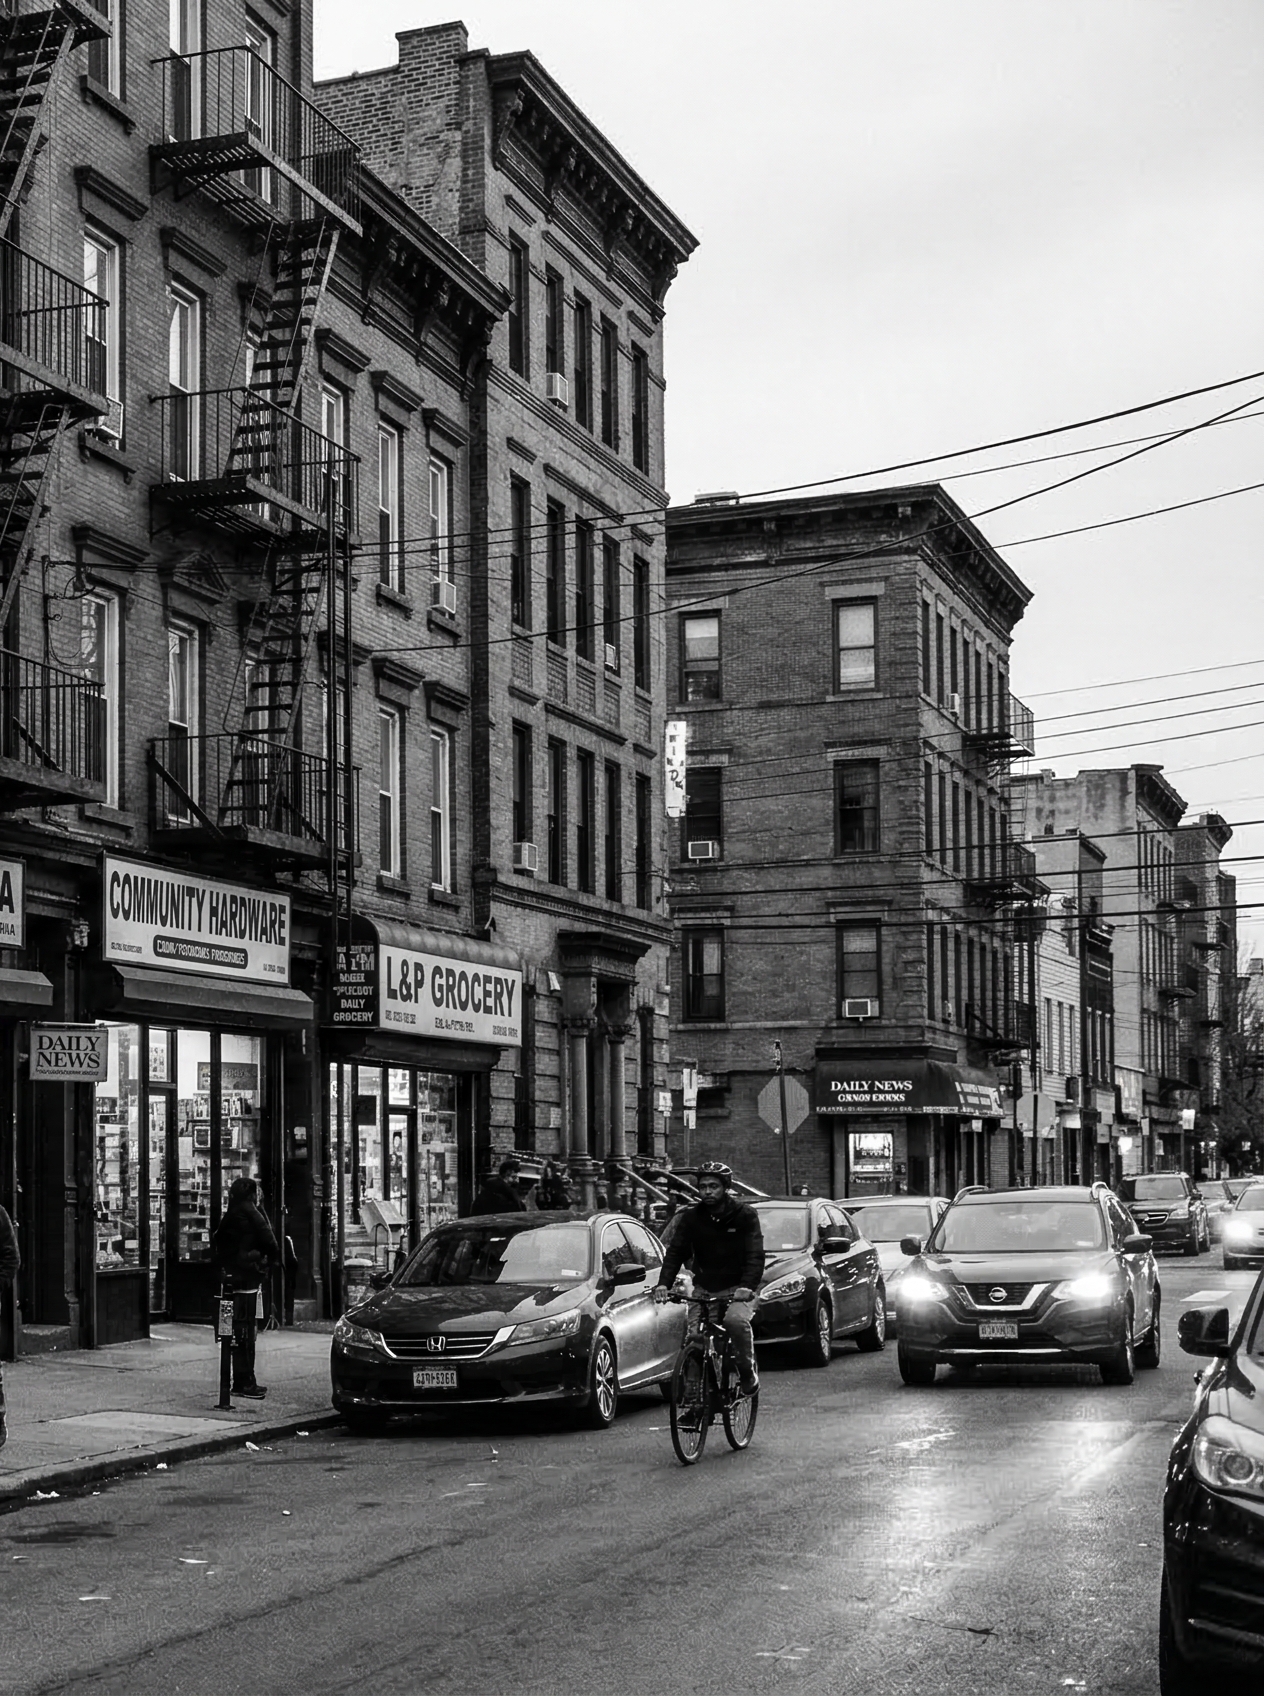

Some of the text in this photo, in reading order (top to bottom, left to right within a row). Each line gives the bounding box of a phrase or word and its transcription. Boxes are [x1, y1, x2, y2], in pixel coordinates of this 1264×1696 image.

[110, 870, 286, 947] COMMUNITY HARDWARE
[386, 955, 516, 1018] L&P GROCERY
[333, 1012, 374, 1022] GROCERY
[37, 1035, 100, 1052] DAILY
[37, 1052, 100, 1069] NEWS
[830, 1080, 913, 1092] DAILY NEWS
